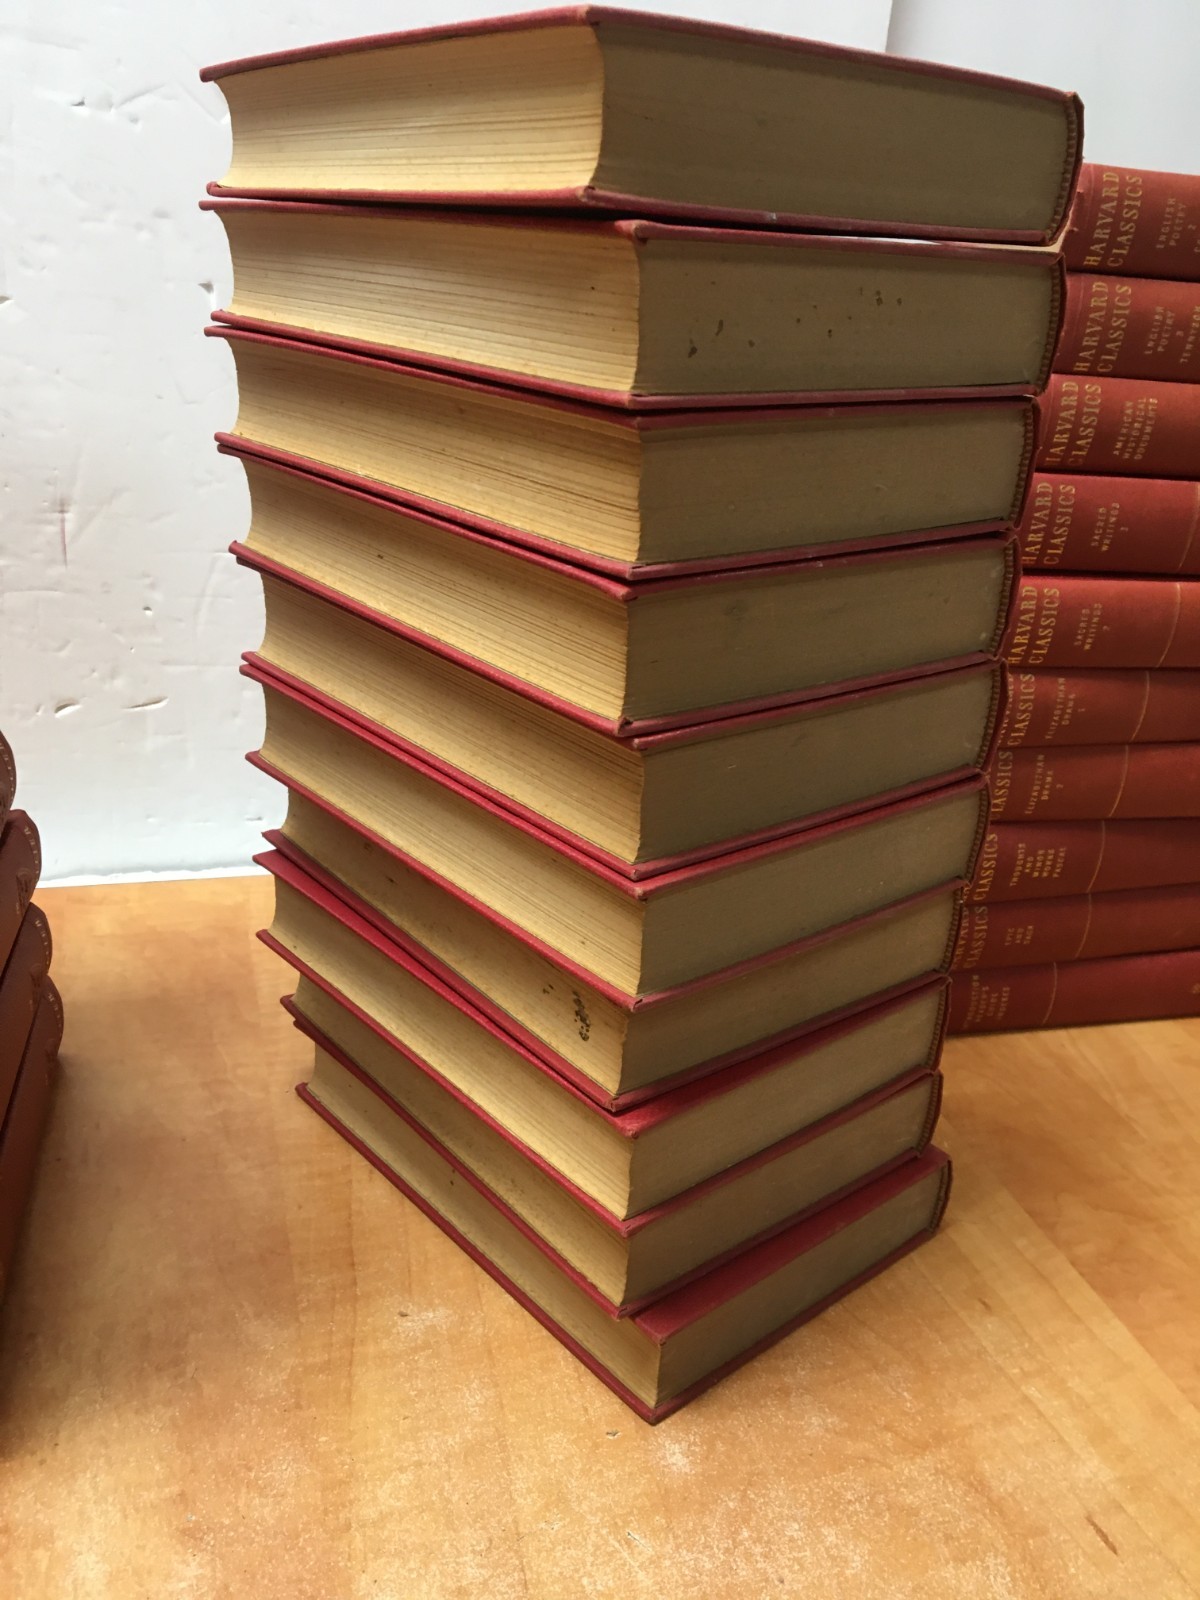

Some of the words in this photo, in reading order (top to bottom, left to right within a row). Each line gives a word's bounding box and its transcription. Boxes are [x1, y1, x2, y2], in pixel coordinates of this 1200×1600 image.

[1083, 172, 1119, 266] HARVARD
[1107, 175, 1142, 267] CLASSICS
[1156, 198, 1176, 249] ENGLISH
[1169, 203, 1187, 246] POETRY
[1073, 282, 1109, 372] HARVARD
[1097, 284, 1131, 372] CLASSICS
[1144, 306, 1165, 355] ENGLISH
[1157, 311, 1175, 352] POETRY
[1044, 382, 1079, 466] HARVARD
[1067, 384, 1101, 466] CLASSICS
[1113, 401, 1134, 456] AMERICAN
[1122, 398, 1146, 459] HISTORICAL
[1134, 398, 1158, 460] DOCUMENTS
[1021, 482, 1053, 564] HARVARD
[1043, 485, 1076, 564] CLASSICS
[1090, 507, 1107, 547] SACRED
[1101, 503, 1120, 552] WRITINGS
[1008, 586, 1038, 664] HARVARD
[1029, 588, 1060, 664] CLASSICS
[1074, 609, 1090, 646] SACRED
[1083, 603, 1102, 650] WRITINGS
[1007, 674, 1036, 746] CLASSICS
[973, 833, 998, 900] CLASSICS
[963, 906, 988, 968] CLASSICS
